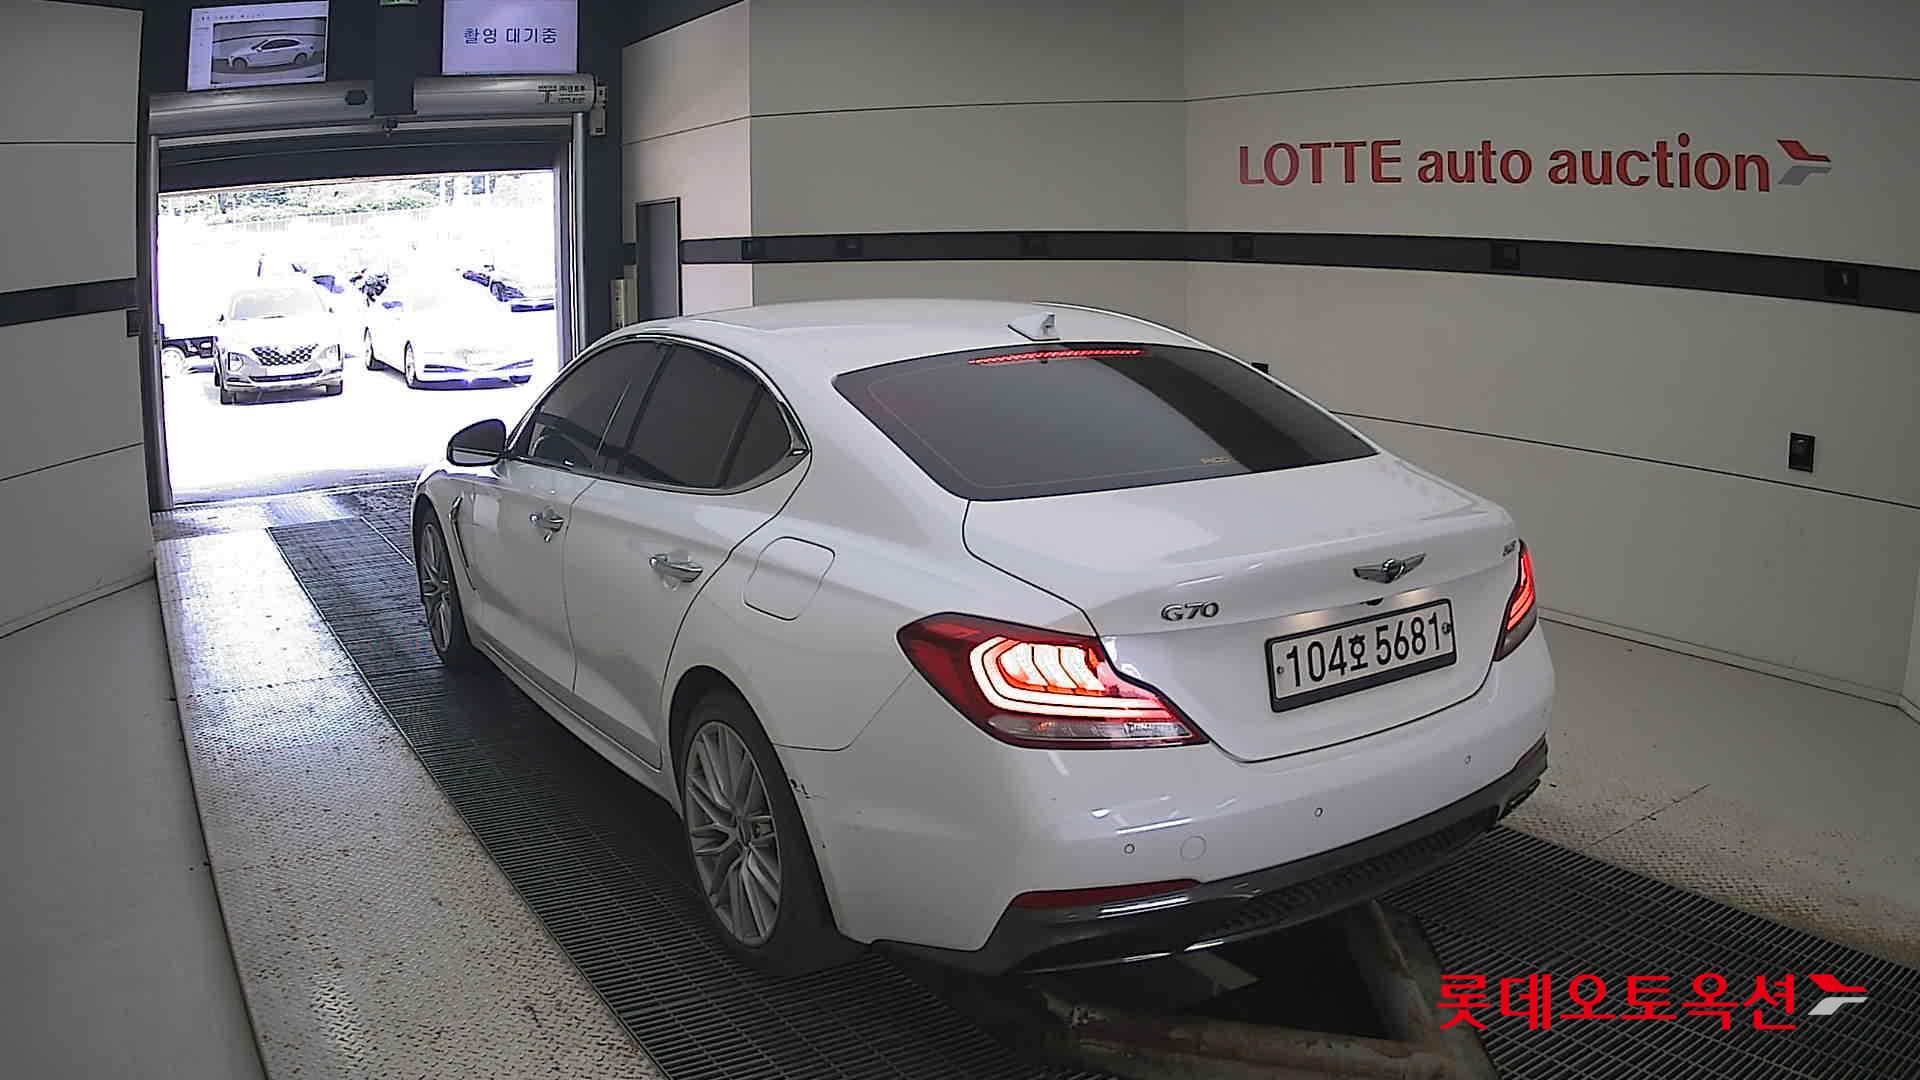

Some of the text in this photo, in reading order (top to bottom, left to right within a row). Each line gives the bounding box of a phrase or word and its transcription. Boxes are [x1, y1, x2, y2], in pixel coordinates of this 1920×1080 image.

[463, 27, 557, 44] 촬영 대기중
[1239, 133, 1771, 192] LOTTE auto auction
[1160, 602, 1219, 621] G70
[1376, 612, 1440, 666] 5681
